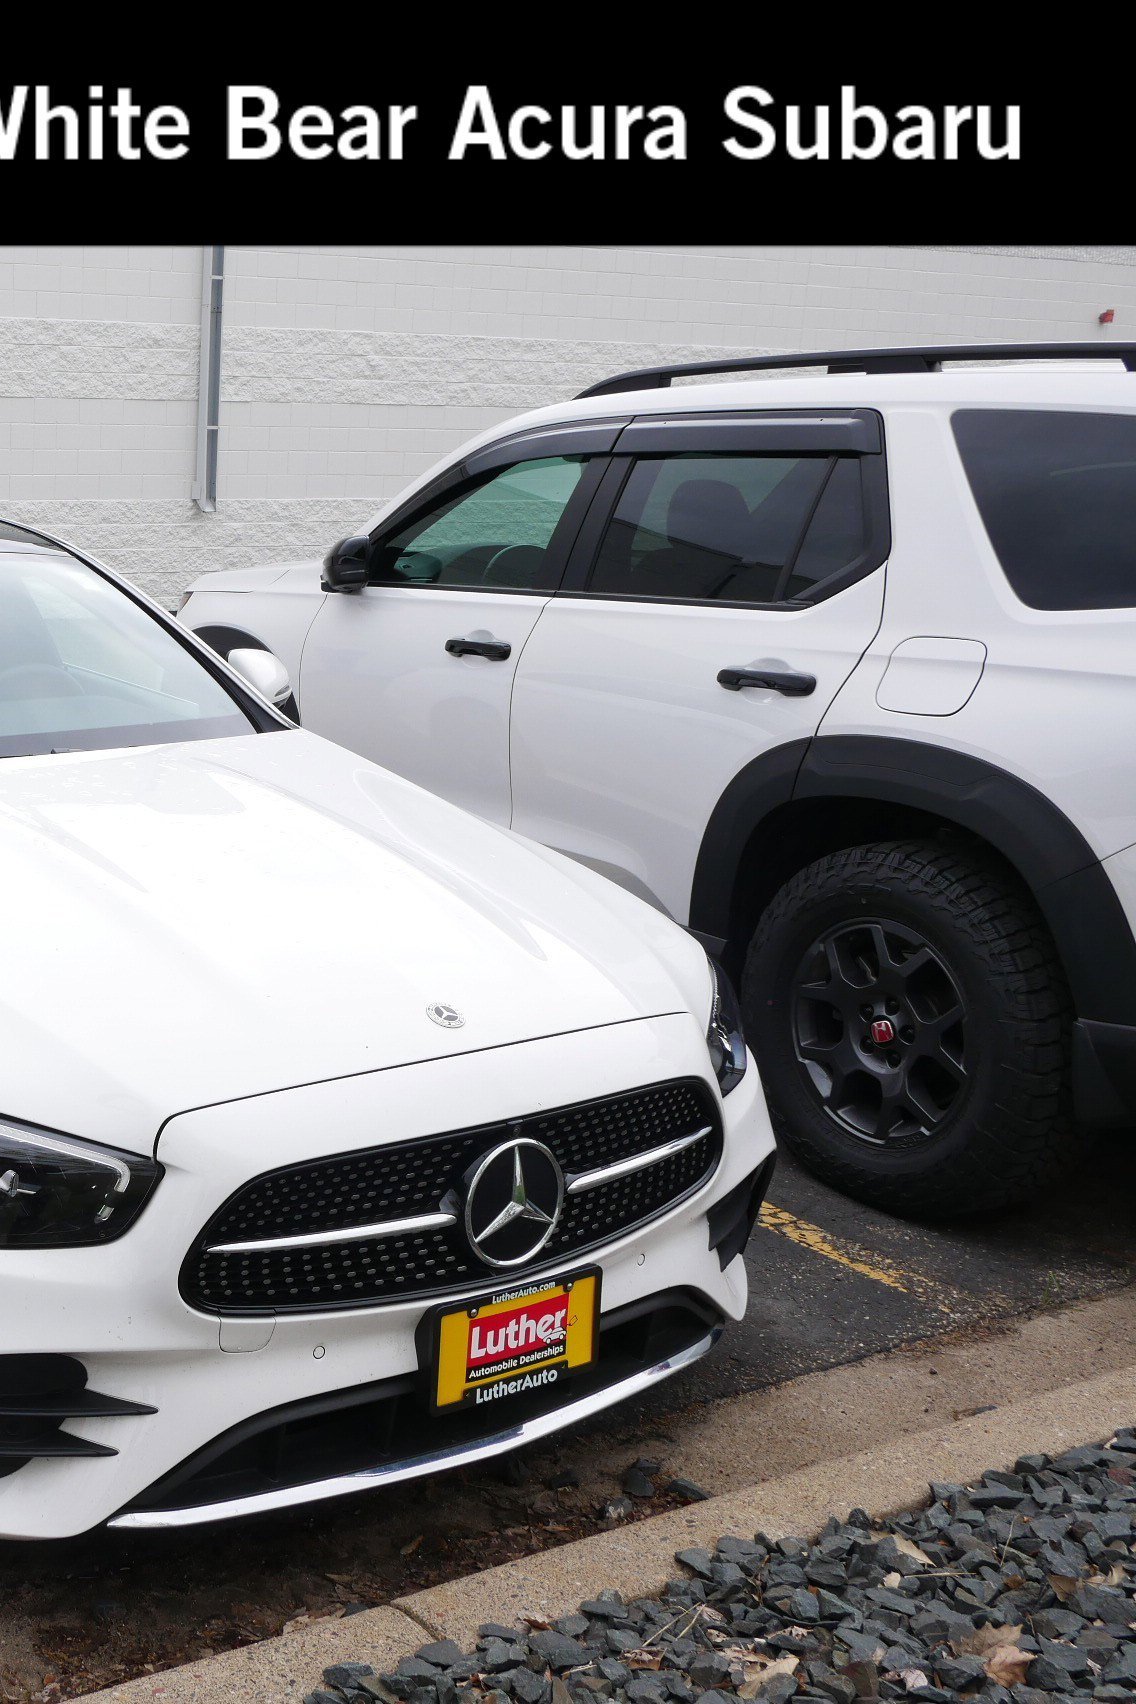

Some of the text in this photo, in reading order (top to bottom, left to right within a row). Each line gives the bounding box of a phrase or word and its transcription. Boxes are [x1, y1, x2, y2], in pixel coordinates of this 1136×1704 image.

[492, 1281, 556, 1305] LutherAuto.com
[470, 1309, 567, 1359] Luther
[468, 1345, 564, 1379] Automobile Dealerships
[475, 1369, 558, 1405] LutherAuto
